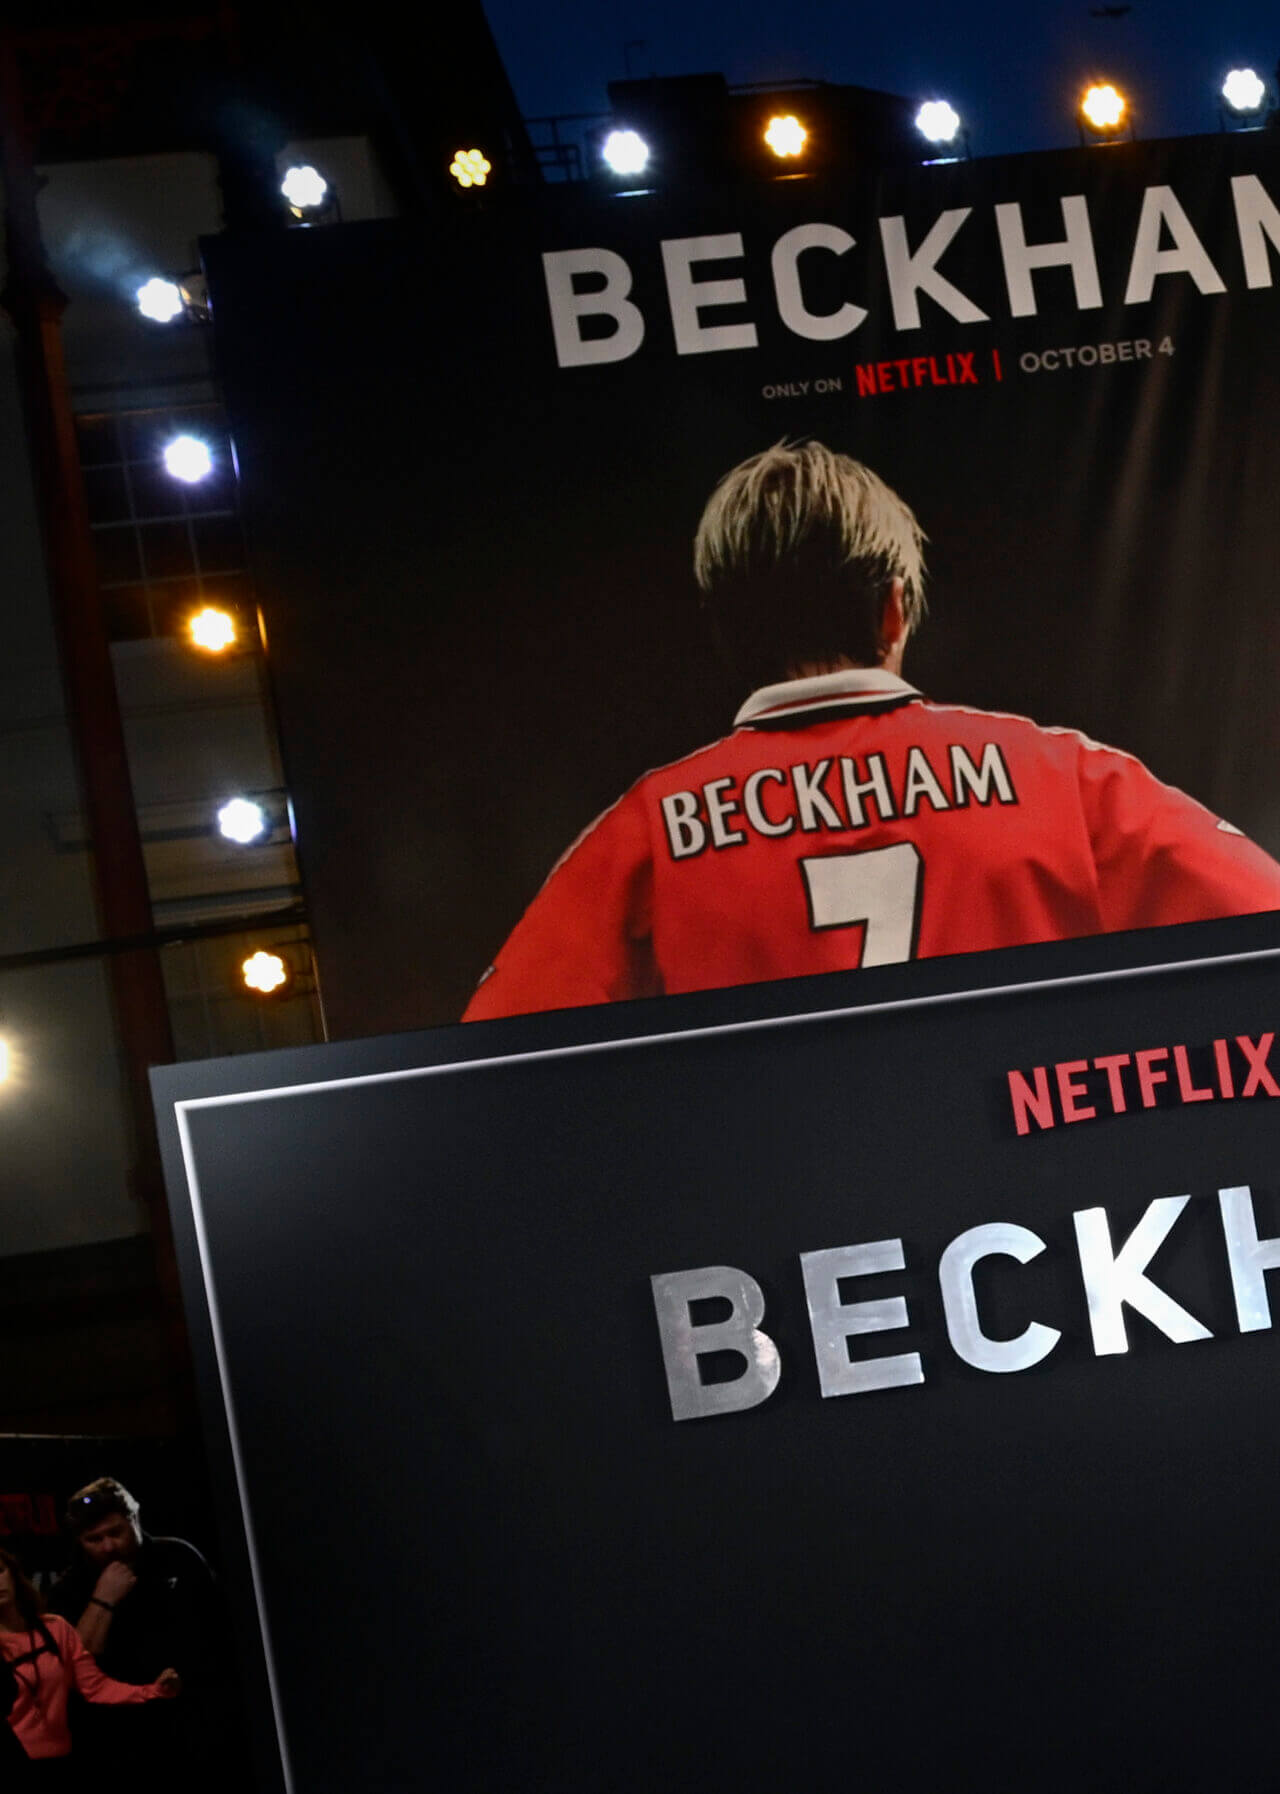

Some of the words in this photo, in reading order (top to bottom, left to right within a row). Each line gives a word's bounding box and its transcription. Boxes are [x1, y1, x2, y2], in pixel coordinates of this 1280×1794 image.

[762, 381, 810, 399] ONLY
[814, 378, 843, 394] ON
[855, 351, 979, 398] NETFLIX
[1019, 339, 1153, 373] OCTOBER
[1158, 335, 1176, 358] 4
[661, 742, 1018, 860] BECKHAM
[802, 842, 924, 970] 7
